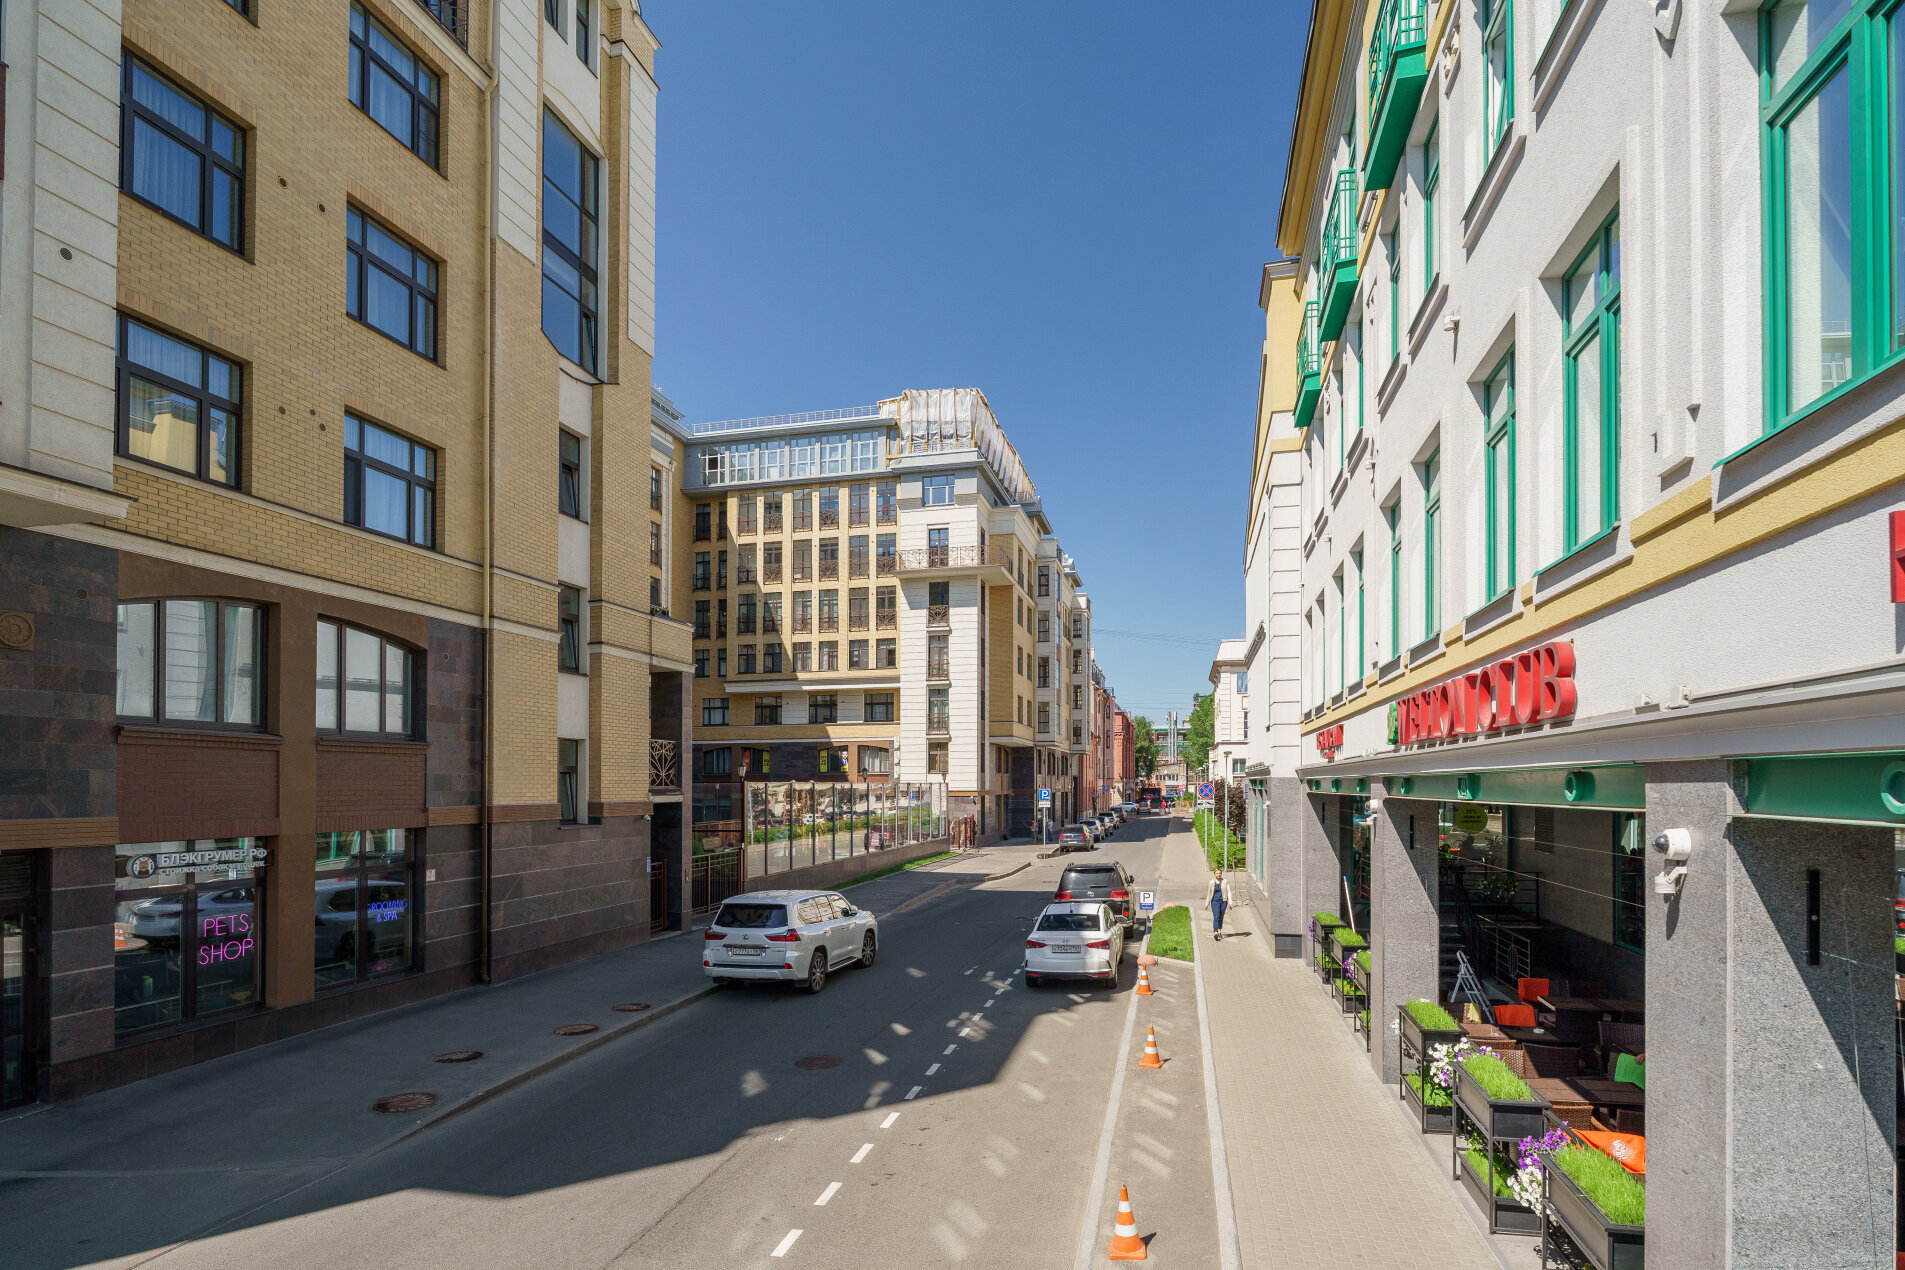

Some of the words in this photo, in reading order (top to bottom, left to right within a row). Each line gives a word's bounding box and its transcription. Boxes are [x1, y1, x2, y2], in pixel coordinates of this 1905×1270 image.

[160, 848, 268, 866] БЛЭКГРУМЕР.РФ
[1143, 892, 1151, 902] P
[383, 910, 398, 922] SPA
[203, 913, 250, 938] PETS
[199, 938, 254, 965] SHOP
